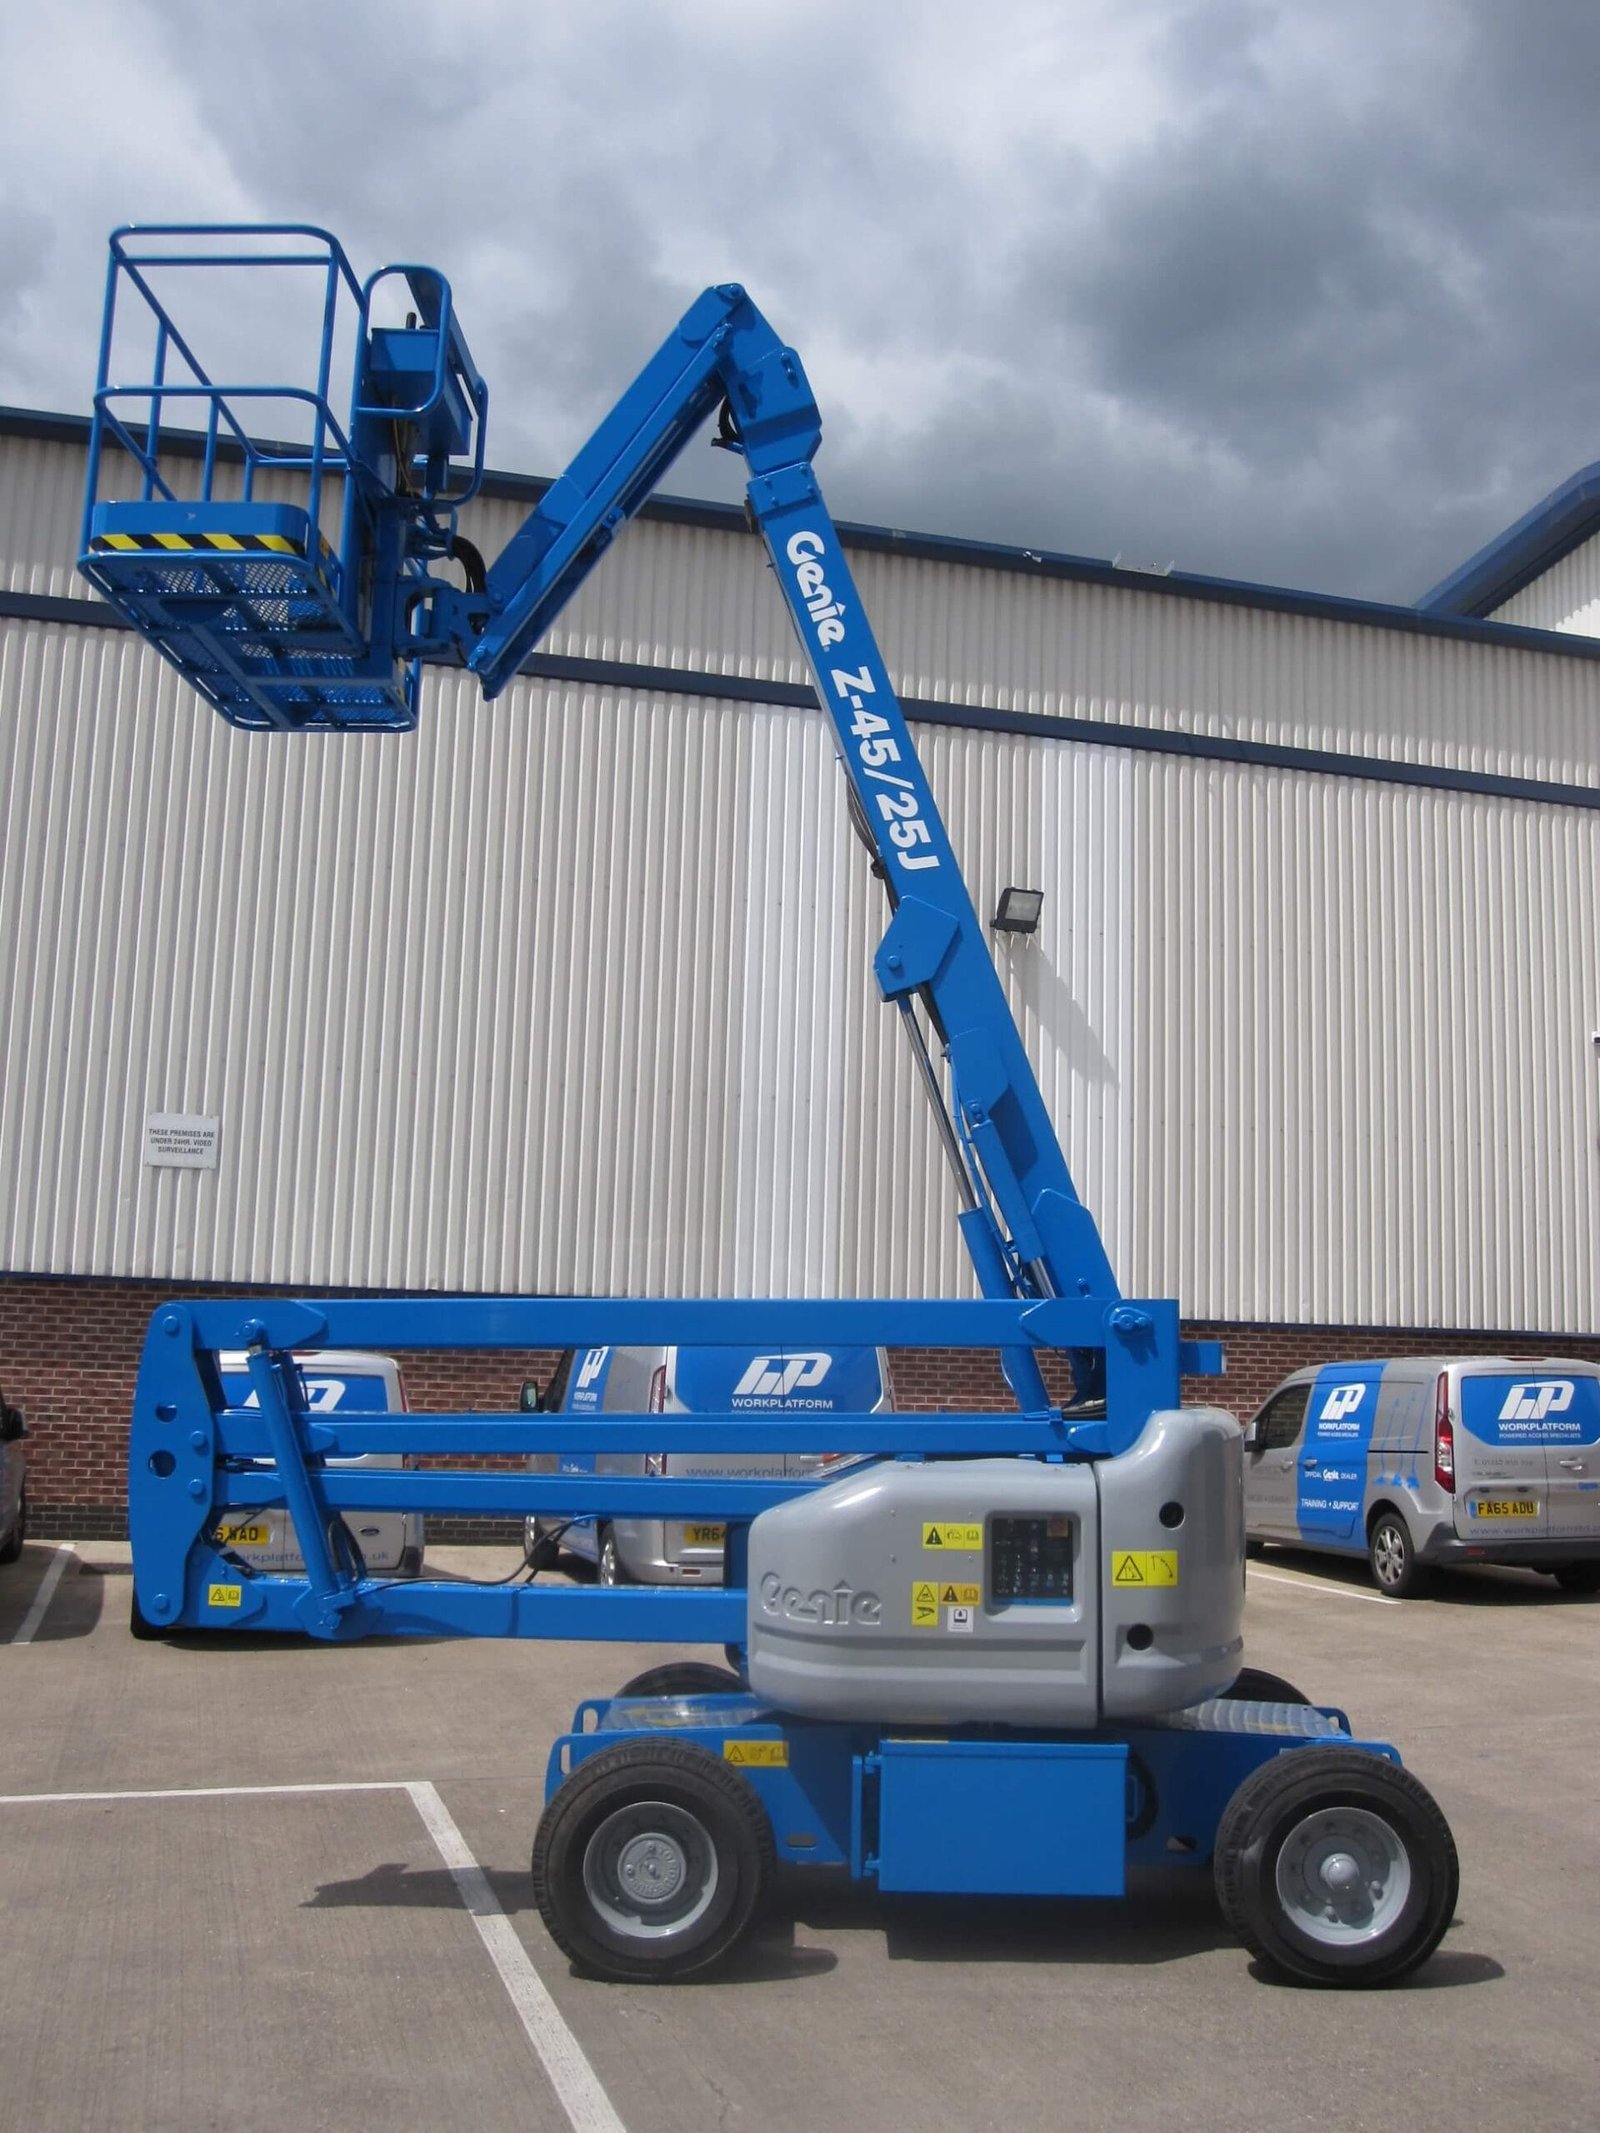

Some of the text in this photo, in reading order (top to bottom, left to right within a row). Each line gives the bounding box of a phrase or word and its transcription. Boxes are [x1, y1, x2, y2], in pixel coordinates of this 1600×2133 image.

[786, 530, 846, 649] Genie
[831, 666, 940, 871] Z-45/25J
[149, 1128, 168, 1137] THESE
[170, 1129, 201, 1138] PREMISES
[150, 1137, 172, 1145] UNDER
[193, 1139, 212, 1147] VIDEO
[157, 1146, 204, 1155] SURVEILLANCE
[731, 1398, 834, 1409] WORKPLATFORM
[1498, 1422, 1581, 1432] WORKPLATFORM
[1301, 1498, 1327, 1509] TRAINING
[1332, 1500, 1359, 1511] SUPPORT
[1478, 1500, 1534, 1515] FA65 ADU
[760, 1571, 882, 1625] Genie
